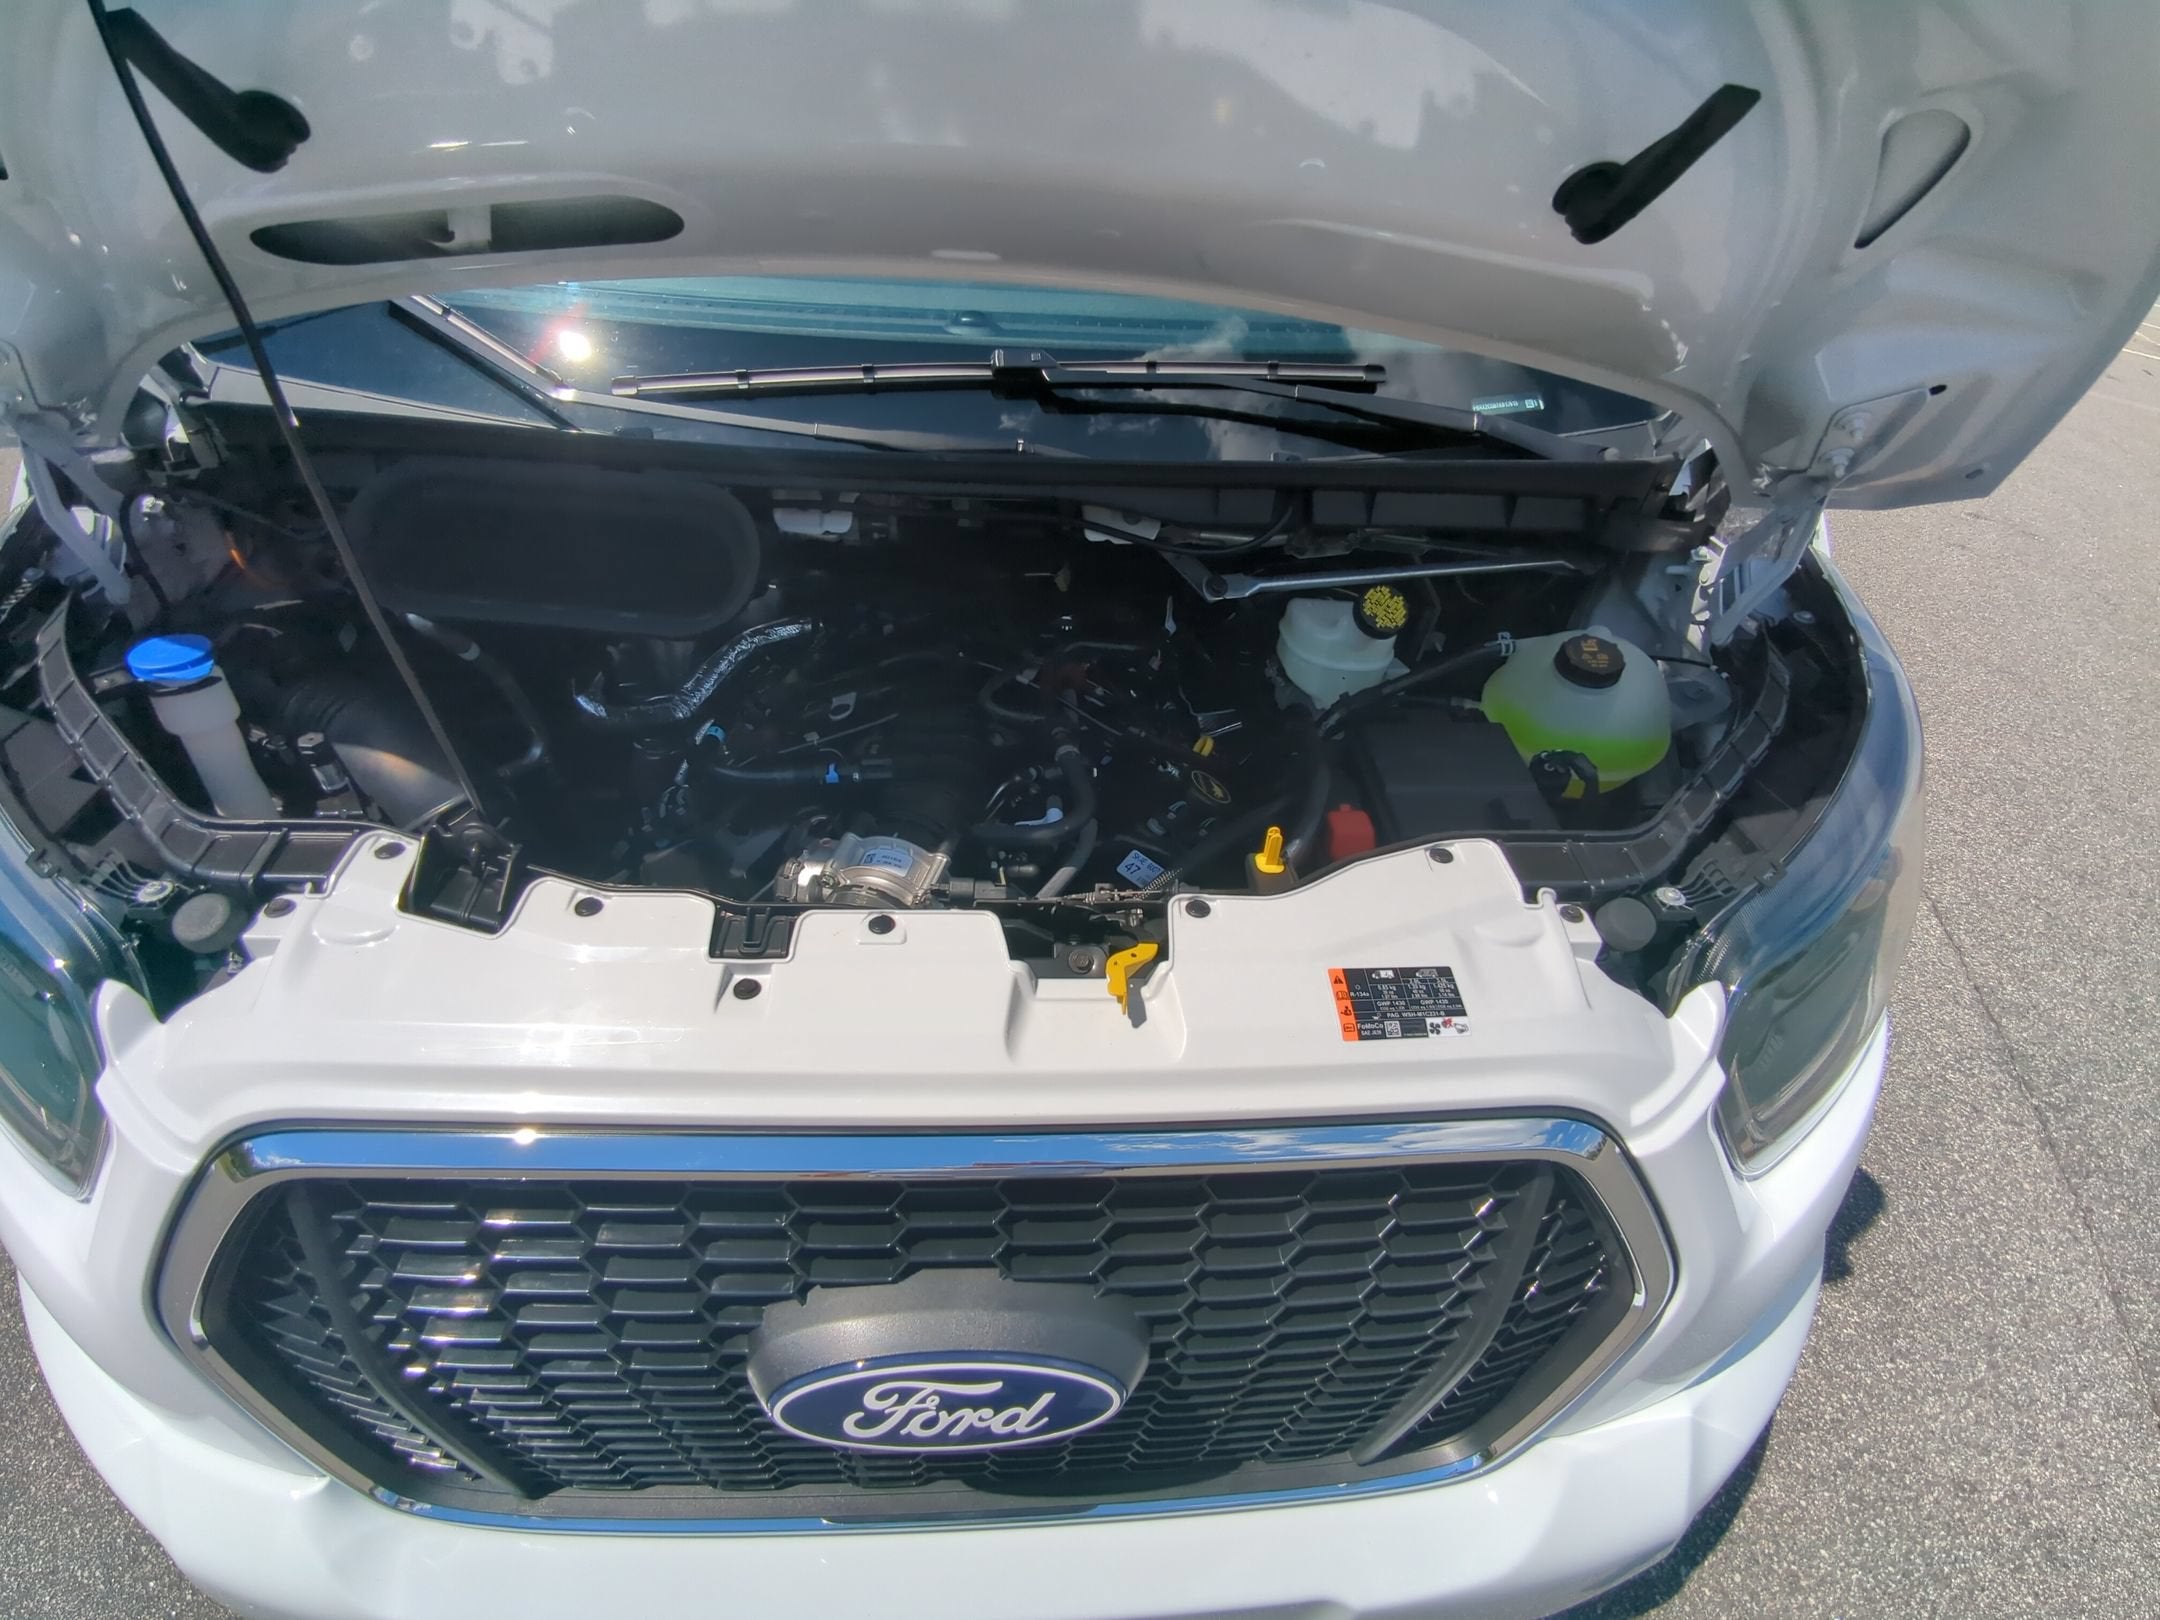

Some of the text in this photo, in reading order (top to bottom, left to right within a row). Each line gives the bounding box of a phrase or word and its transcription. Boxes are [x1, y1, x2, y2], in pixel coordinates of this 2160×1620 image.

[1124, 862, 1141, 875] 47
[1357, 1022, 1384, 1030] FoMoCo
[842, 1380, 1056, 1438] Ford
